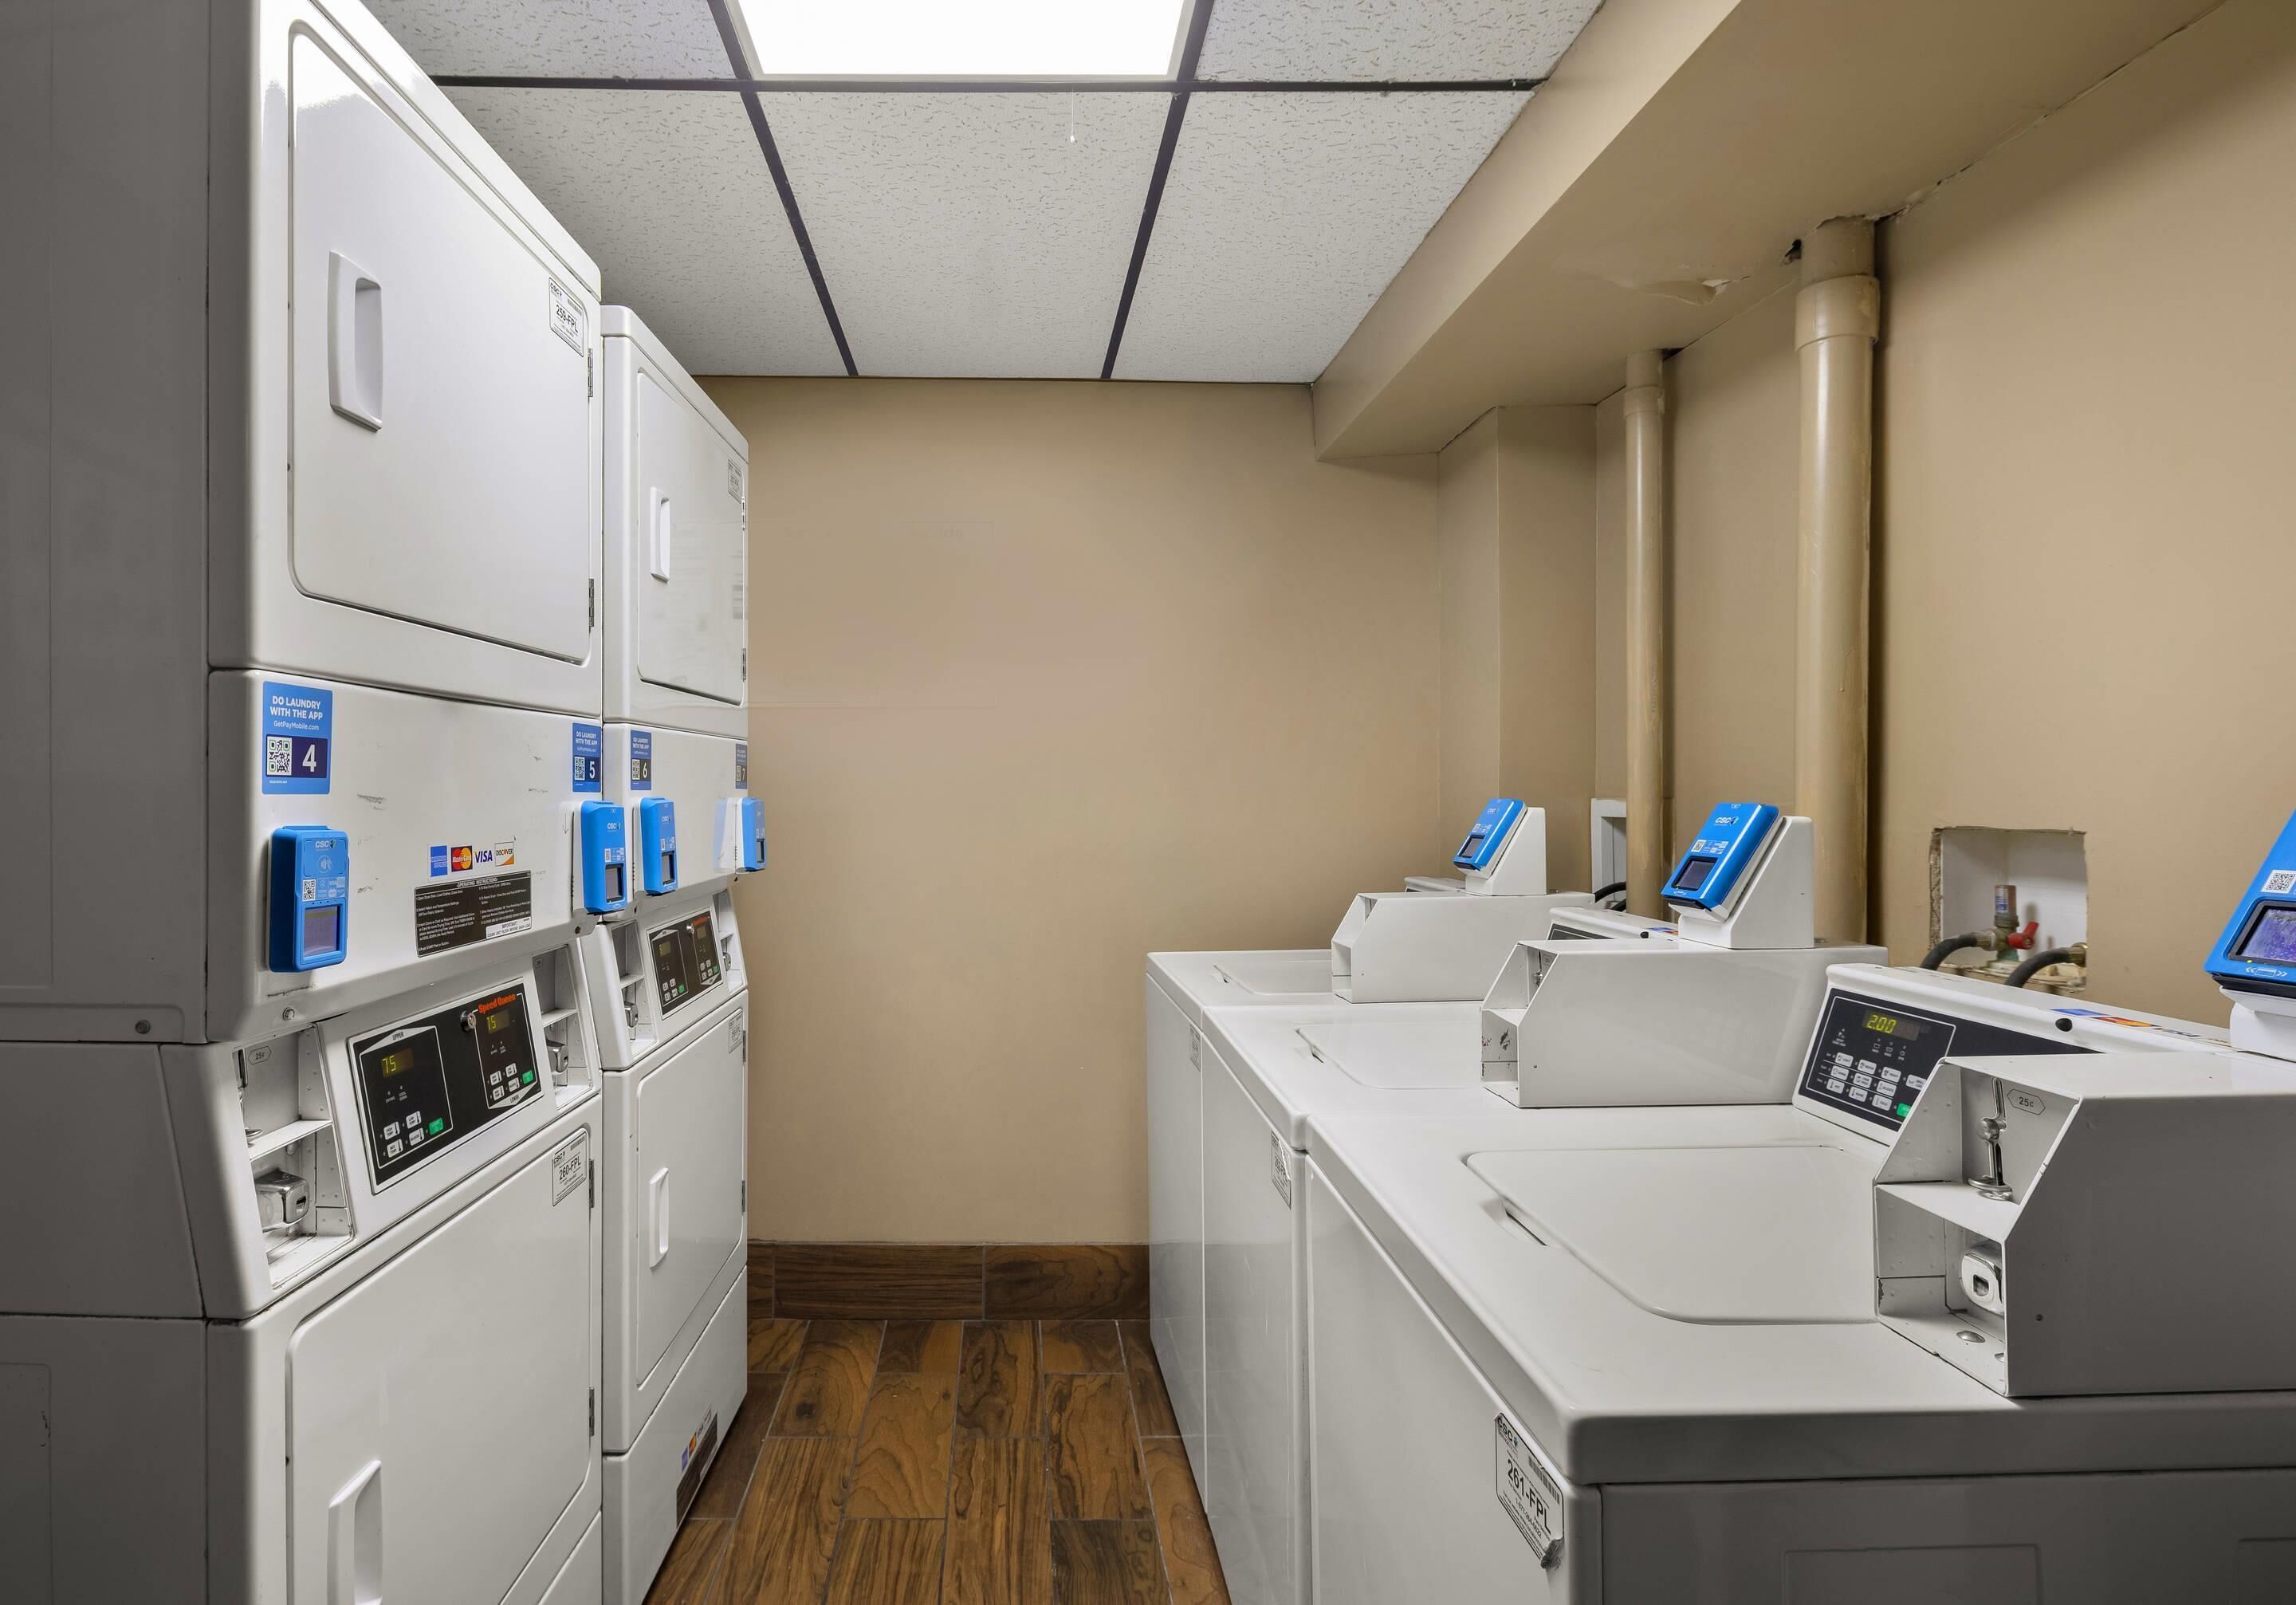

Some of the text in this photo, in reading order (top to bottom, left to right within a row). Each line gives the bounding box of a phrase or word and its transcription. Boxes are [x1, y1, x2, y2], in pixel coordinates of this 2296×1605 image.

[556, 305, 579, 333] 259-FPL
[272, 695, 321, 710] DO LAUNDRY
[269, 706, 323, 720] WITH THE APP
[273, 720, 319, 730] GetPayMobile.com
[302, 744, 317, 773] 4
[589, 761, 596, 779] 5
[643, 762, 647, 779] 6
[474, 850, 493, 863] VISA
[478, 993, 516, 1014] Speed Queen
[1866, 1014, 1897, 1034] 2.00
[391, 1032, 404, 1040] UPPER
[383, 1055, 396, 1074] 75
[559, 1155, 581, 1181] 260-FPL
[1497, 1417, 1513, 1442] CSC
[1508, 1458, 1551, 1536] 261-FPL
